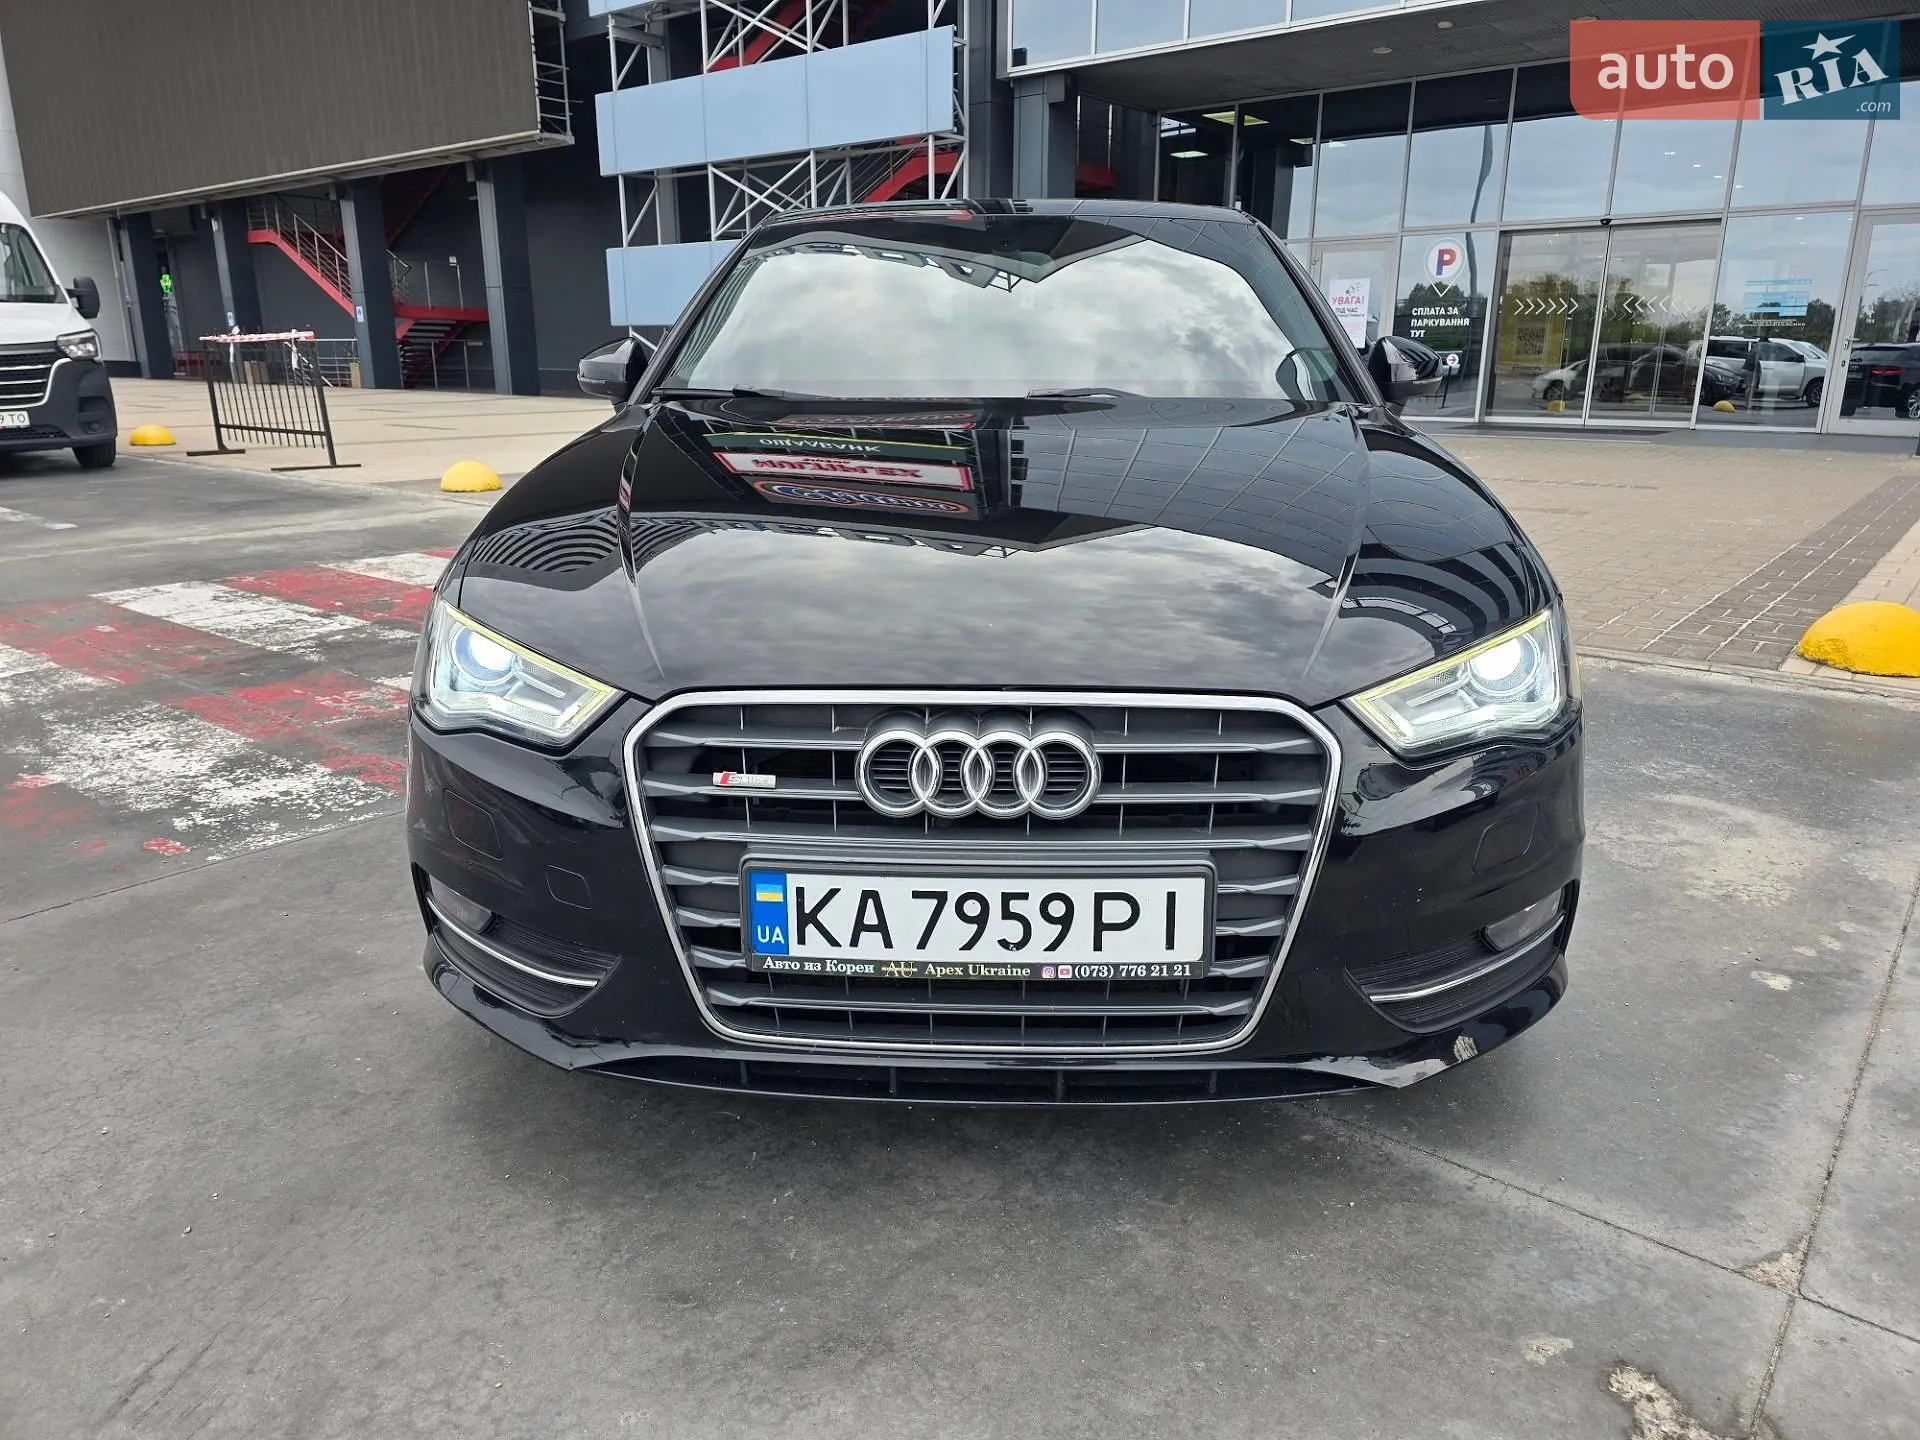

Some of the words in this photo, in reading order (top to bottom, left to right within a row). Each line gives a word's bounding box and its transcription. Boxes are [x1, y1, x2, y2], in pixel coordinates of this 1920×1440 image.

[1332, 295, 1365, 305] УВАГА!
[1411, 306, 1446, 316] СПЛАТА
[1446, 306, 1459, 315] ЗА
[1410, 317, 1470, 328] ПАРКУВАННЯ
[1410, 329, 1426, 338] ТУТ
[757, 925, 785, 944] UA
[763, 957, 801, 970] Авто
[804, 963, 822, 971] из
[925, 964, 964, 976] Apex
[968, 964, 1031, 977] Ukraine
[1074, 965, 1114, 978] (073)
[1119, 965, 1147, 977] 776
[1151, 965, 1169, 976] 21
[1173, 964, 1191, 976] 21
